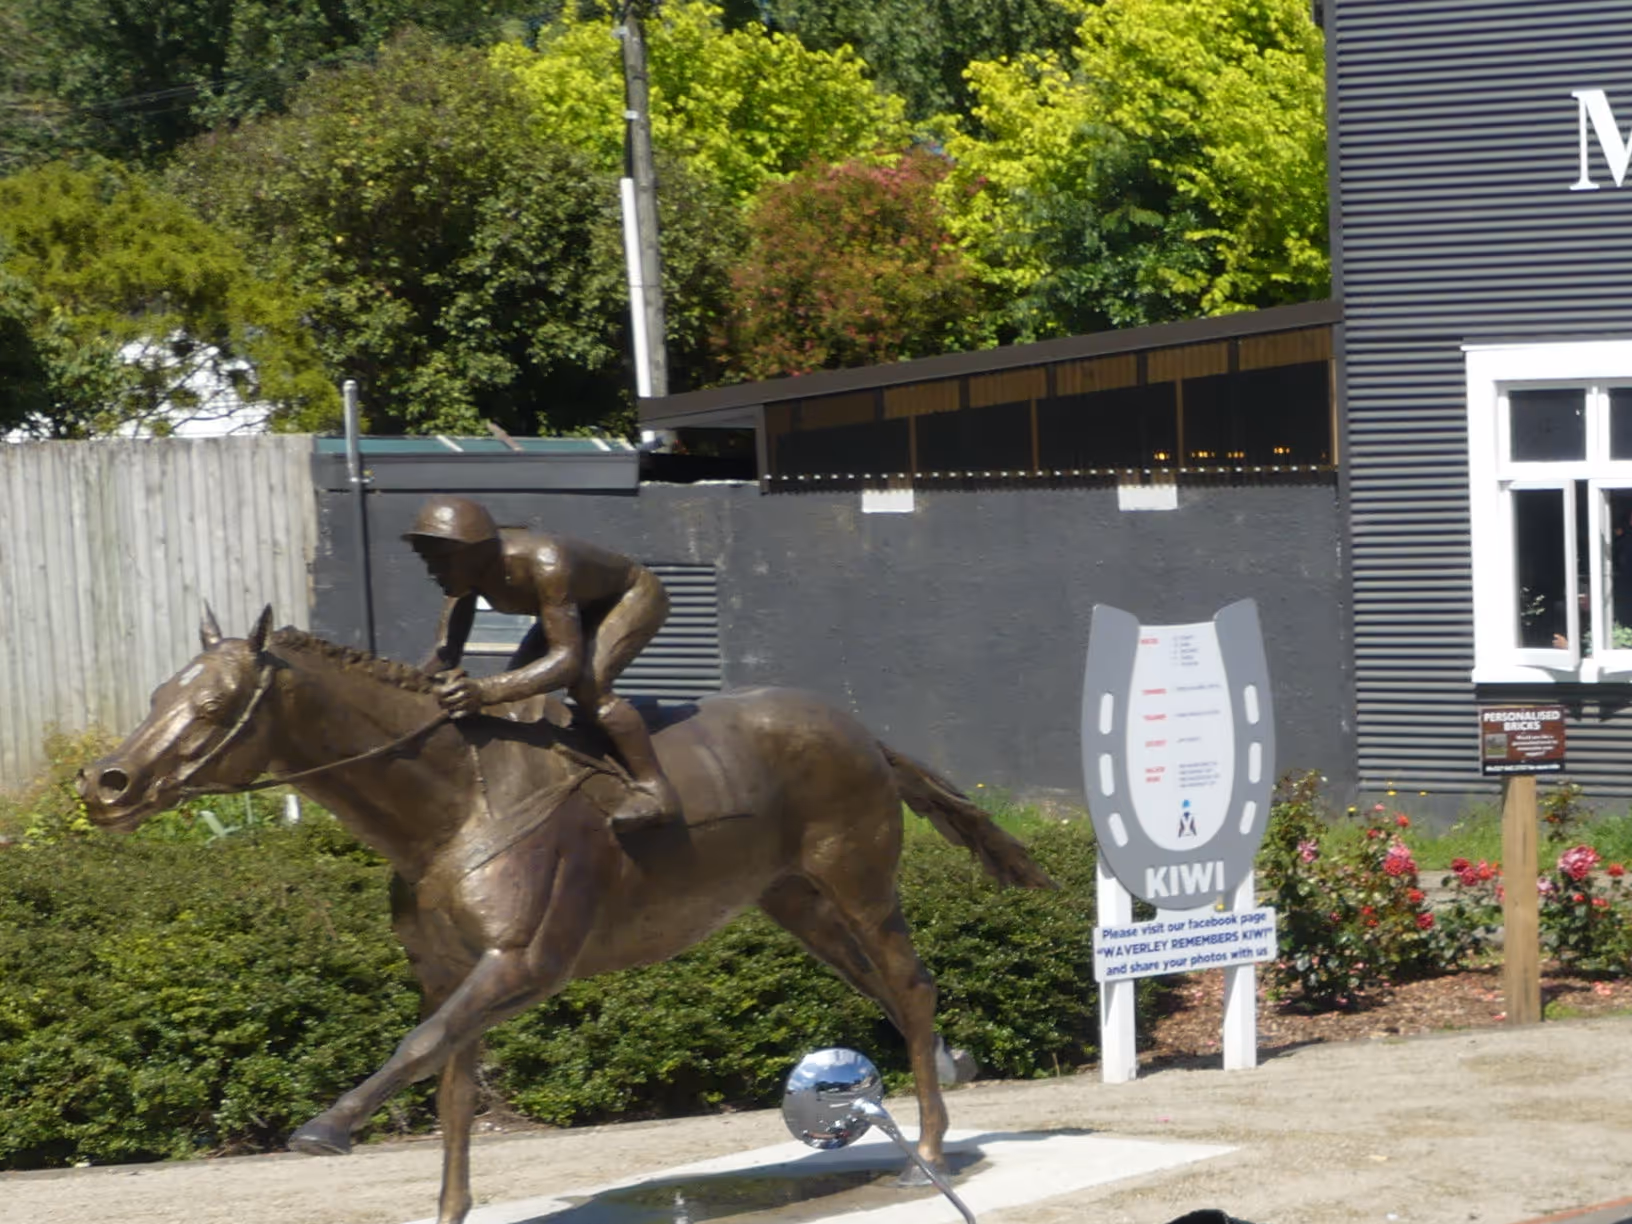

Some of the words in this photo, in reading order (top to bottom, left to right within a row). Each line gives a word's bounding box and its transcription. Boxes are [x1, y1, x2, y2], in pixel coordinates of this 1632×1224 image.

[1503, 721, 1542, 731] BRICKS
[1145, 860, 1225, 899] KIWI
[1102, 928, 1138, 939] Please
[1142, 922, 1164, 935] visit
[1168, 921, 1186, 932] our
[1188, 914, 1237, 929] facebook
[1240, 912, 1267, 926] page
[1171, 931, 1240, 949] REMEMBERS
[1106, 964, 1127, 976] and
[1130, 961, 1160, 973] share
[1163, 958, 1187, 972] your
[1190, 952, 1227, 967] photos
[1230, 947, 1254, 959] with
[1256, 946, 1268, 957] us
